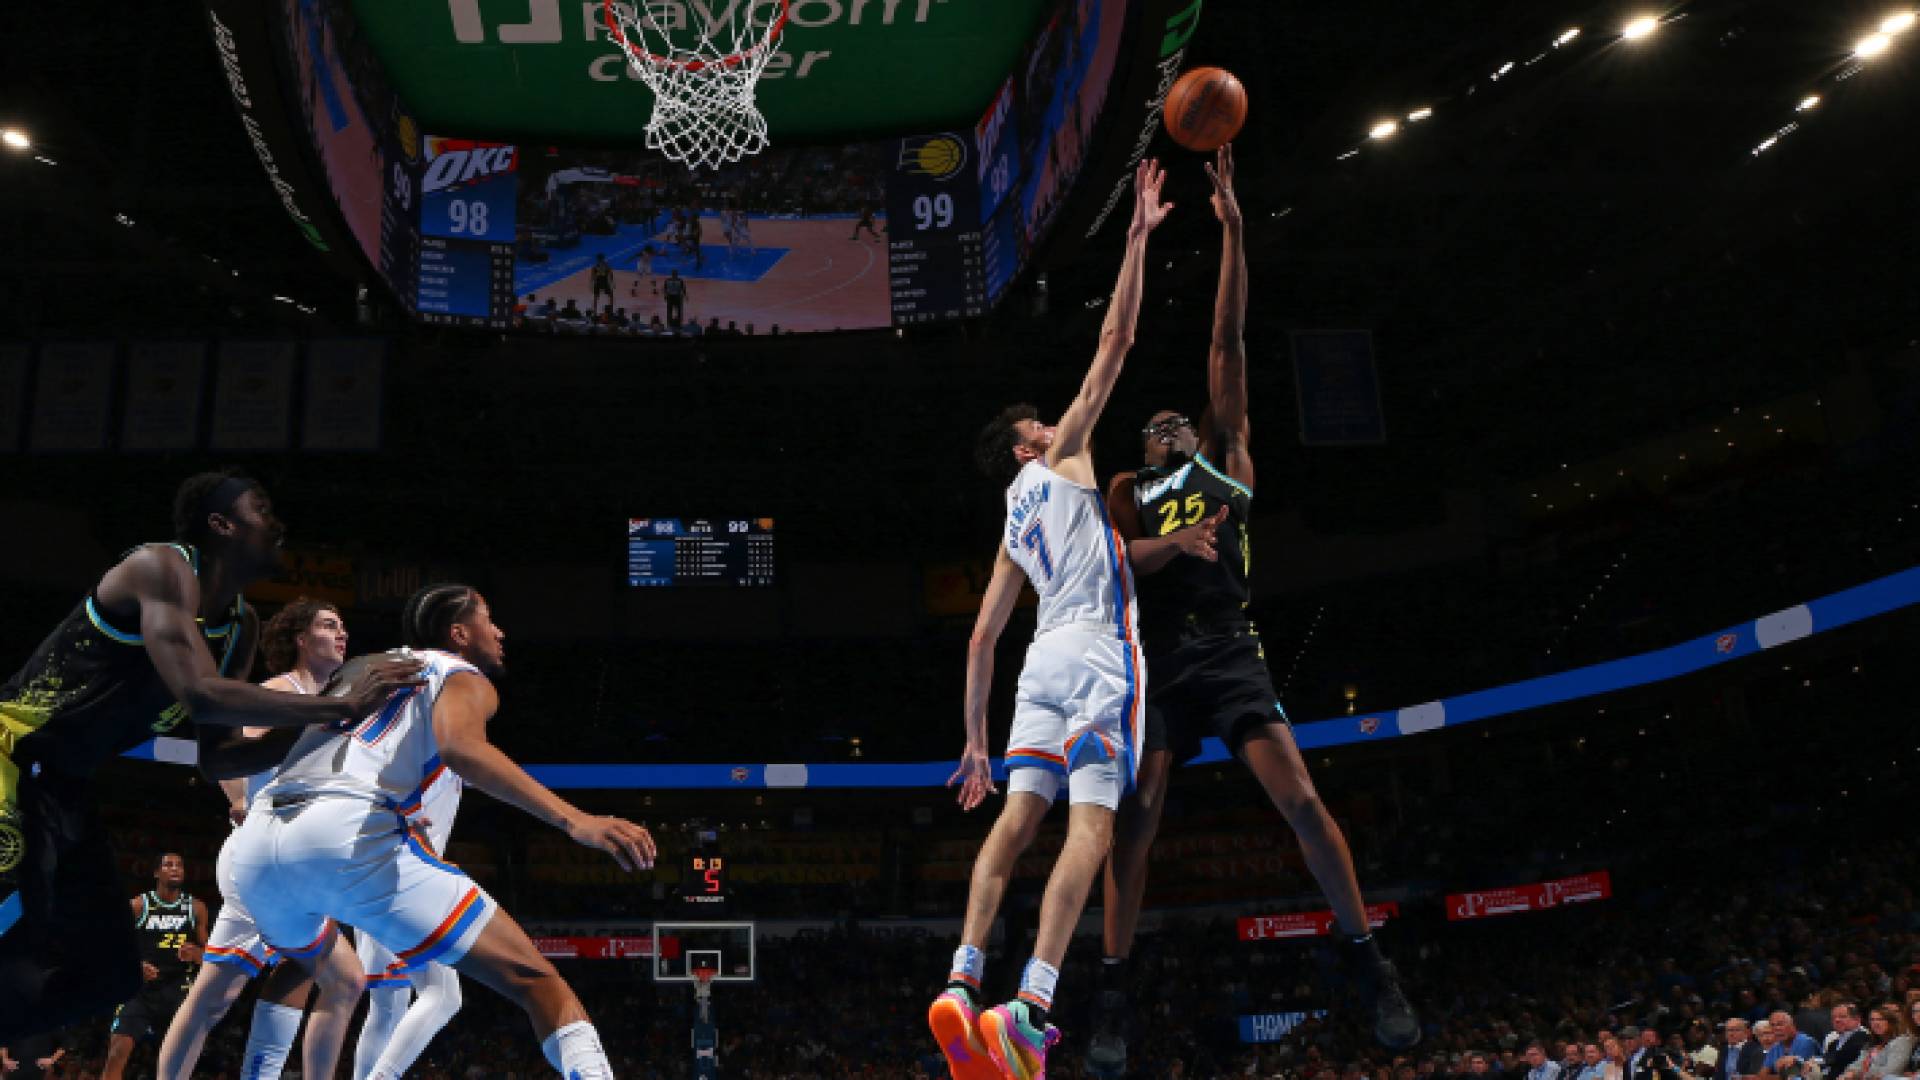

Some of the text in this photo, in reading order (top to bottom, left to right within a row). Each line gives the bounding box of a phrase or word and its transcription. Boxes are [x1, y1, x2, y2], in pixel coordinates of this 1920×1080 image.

[421, 146, 513, 192] OKC
[448, 199, 489, 236] 98
[912, 193, 953, 231] 99
[728, 520, 749, 533] 99
[1158, 491, 1205, 536] 25
[1021, 518, 1054, 581] 7
[704, 869, 719, 892] 5
